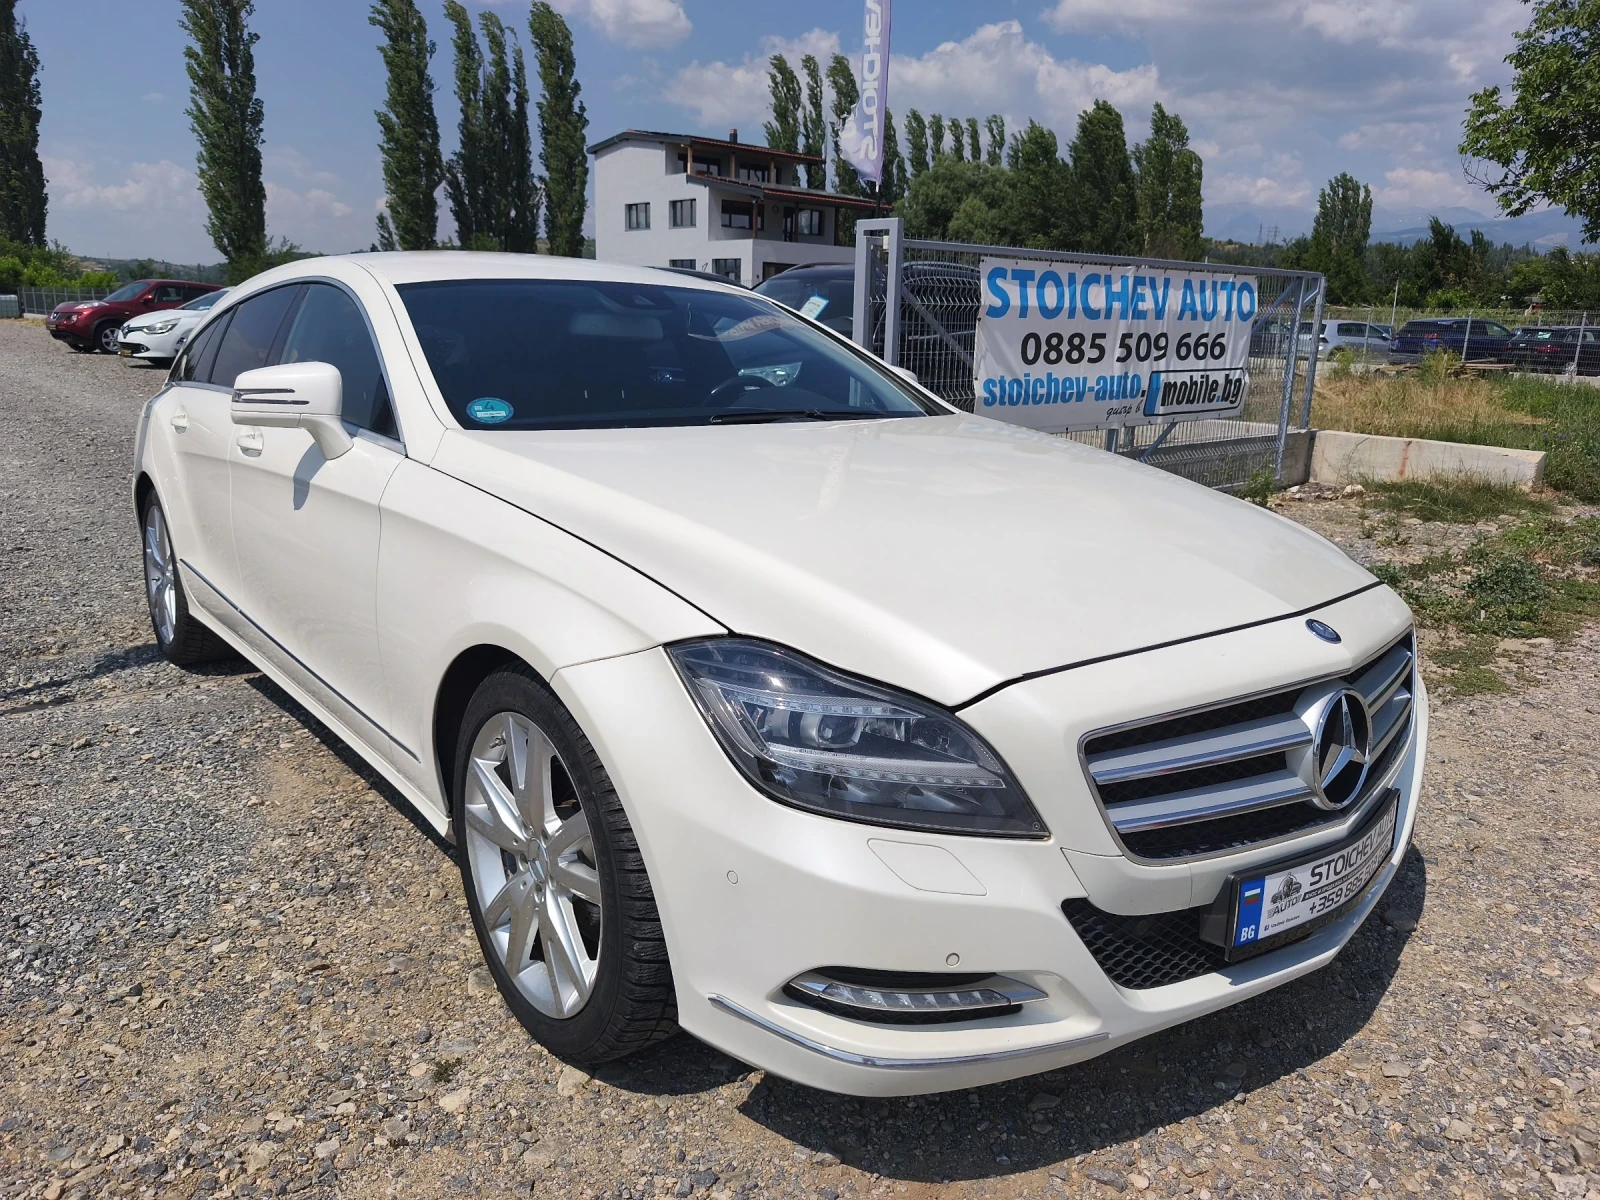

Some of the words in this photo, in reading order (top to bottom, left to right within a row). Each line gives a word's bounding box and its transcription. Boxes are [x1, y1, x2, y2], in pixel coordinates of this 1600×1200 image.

[985, 266, 1170, 322] STOICHEV
[1177, 278, 1256, 323] AUTO
[1020, 331, 1107, 366] 0885
[1116, 332, 1169, 363] 509
[1175, 332, 1226, 361] 666
[1160, 374, 1242, 407] mobile.bg
[1309, 828, 1377, 887] STOICHEV
[1308, 887, 1344, 915] +359
[1240, 924, 1256, 942] BG
